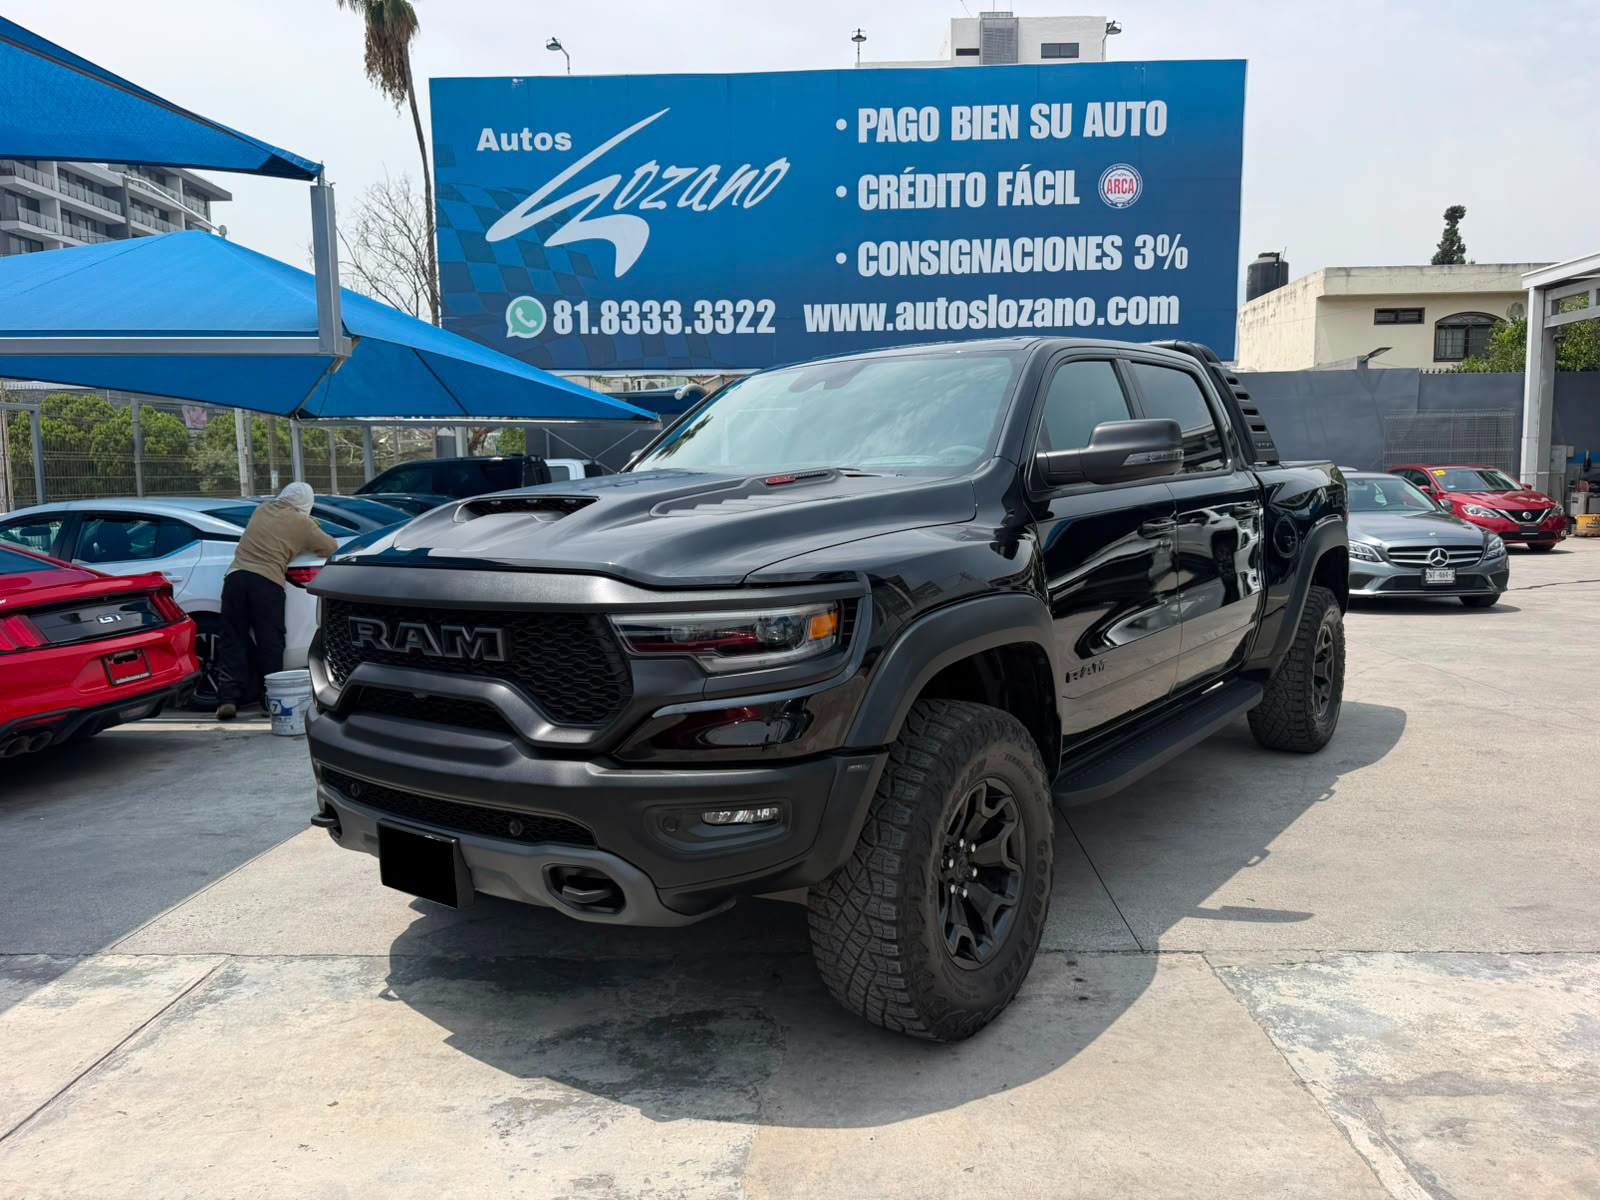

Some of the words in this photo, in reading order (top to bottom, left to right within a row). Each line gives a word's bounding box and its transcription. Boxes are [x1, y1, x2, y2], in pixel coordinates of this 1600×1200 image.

[476, 127, 572, 151] Autos
[858, 107, 940, 143] PAGO
[951, 105, 1019, 141] BIEN
[1030, 102, 1072, 139] SU
[1083, 100, 1168, 138] AUTO
[485, 107, 791, 278] Lozano
[858, 166, 986, 210] CRÉDITO
[998, 163, 1081, 206] FÁCIL
[1106, 178, 1135, 194] ARCA
[858, 234, 1123, 277] CONSIGNACIONES
[1134, 234, 1189, 270] 3%
[553, 299, 776, 334] 81.8333.3322
[803, 294, 1180, 333] www.autoslozano.com
[96, 614, 122, 625] GT
[348, 615, 506, 662] RAM
[1065, 659, 1107, 684] RAM
